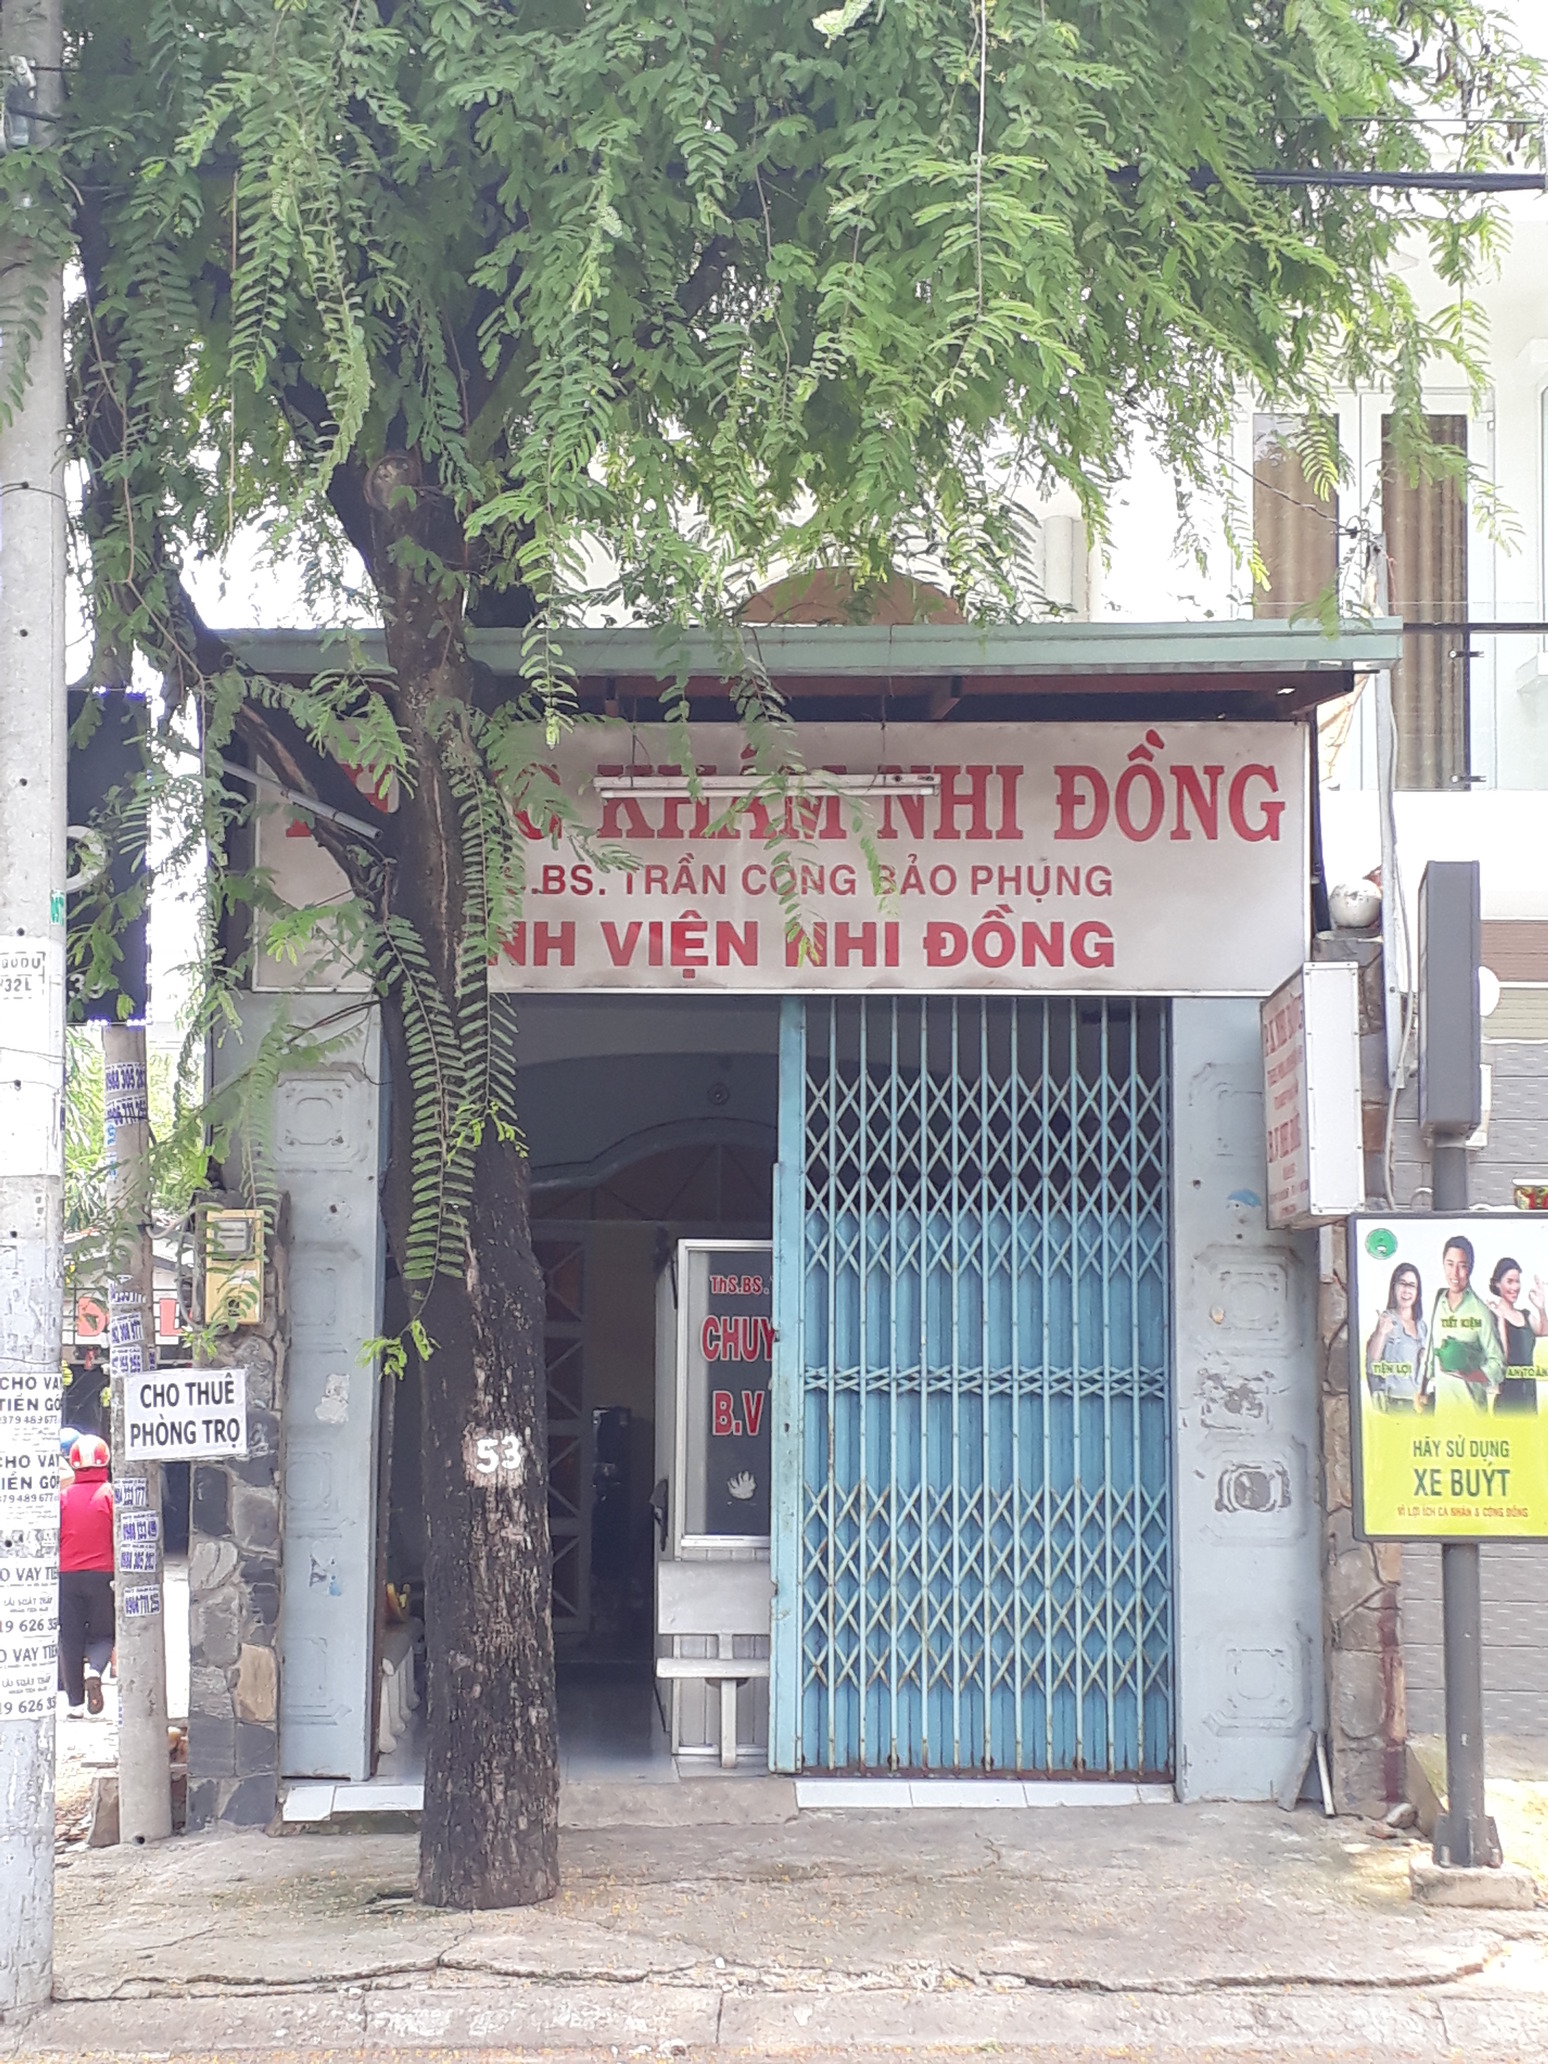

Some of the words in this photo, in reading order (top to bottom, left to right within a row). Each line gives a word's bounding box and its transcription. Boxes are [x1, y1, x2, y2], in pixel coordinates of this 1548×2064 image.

[877, 764, 1025, 840] NHI
[1053, 728, 1286, 842] ĐỒNG
[970, 864, 1113, 903] PHỤNG
[599, 908, 758, 979] VIỆN
[784, 921, 900, 967] NHI
[923, 903, 1115, 968] ĐỒNG
[710, 1275, 770, 1295] ThS.BS.
[700, 1314, 775, 1362] CHUY
[0, 1376, 37, 1390] CHO
[140, 1383, 180, 1408] CHO
[185, 1372, 235, 1406] THUÊ
[130, 1413, 197, 1447] PHÒNG
[201, 1418, 241, 1448] TRỌ
[0, 1454, 31, 1469] HO
[476, 1435, 522, 1473] 53
[1413, 1436, 1441, 1457] HÃY
[1446, 1434, 1466, 1458] SỬ
[1469, 1440, 1510, 1462] DỤNG
[1413, 1468, 1442, 1496] XE
[1450, 1461, 1511, 1497] BUÝT
[15, 1566, 42, 1581] VAY
[18, 1618, 45, 1632] 626
[12, 1646, 39, 1662] VAY
[18, 1698, 43, 1714] 626
